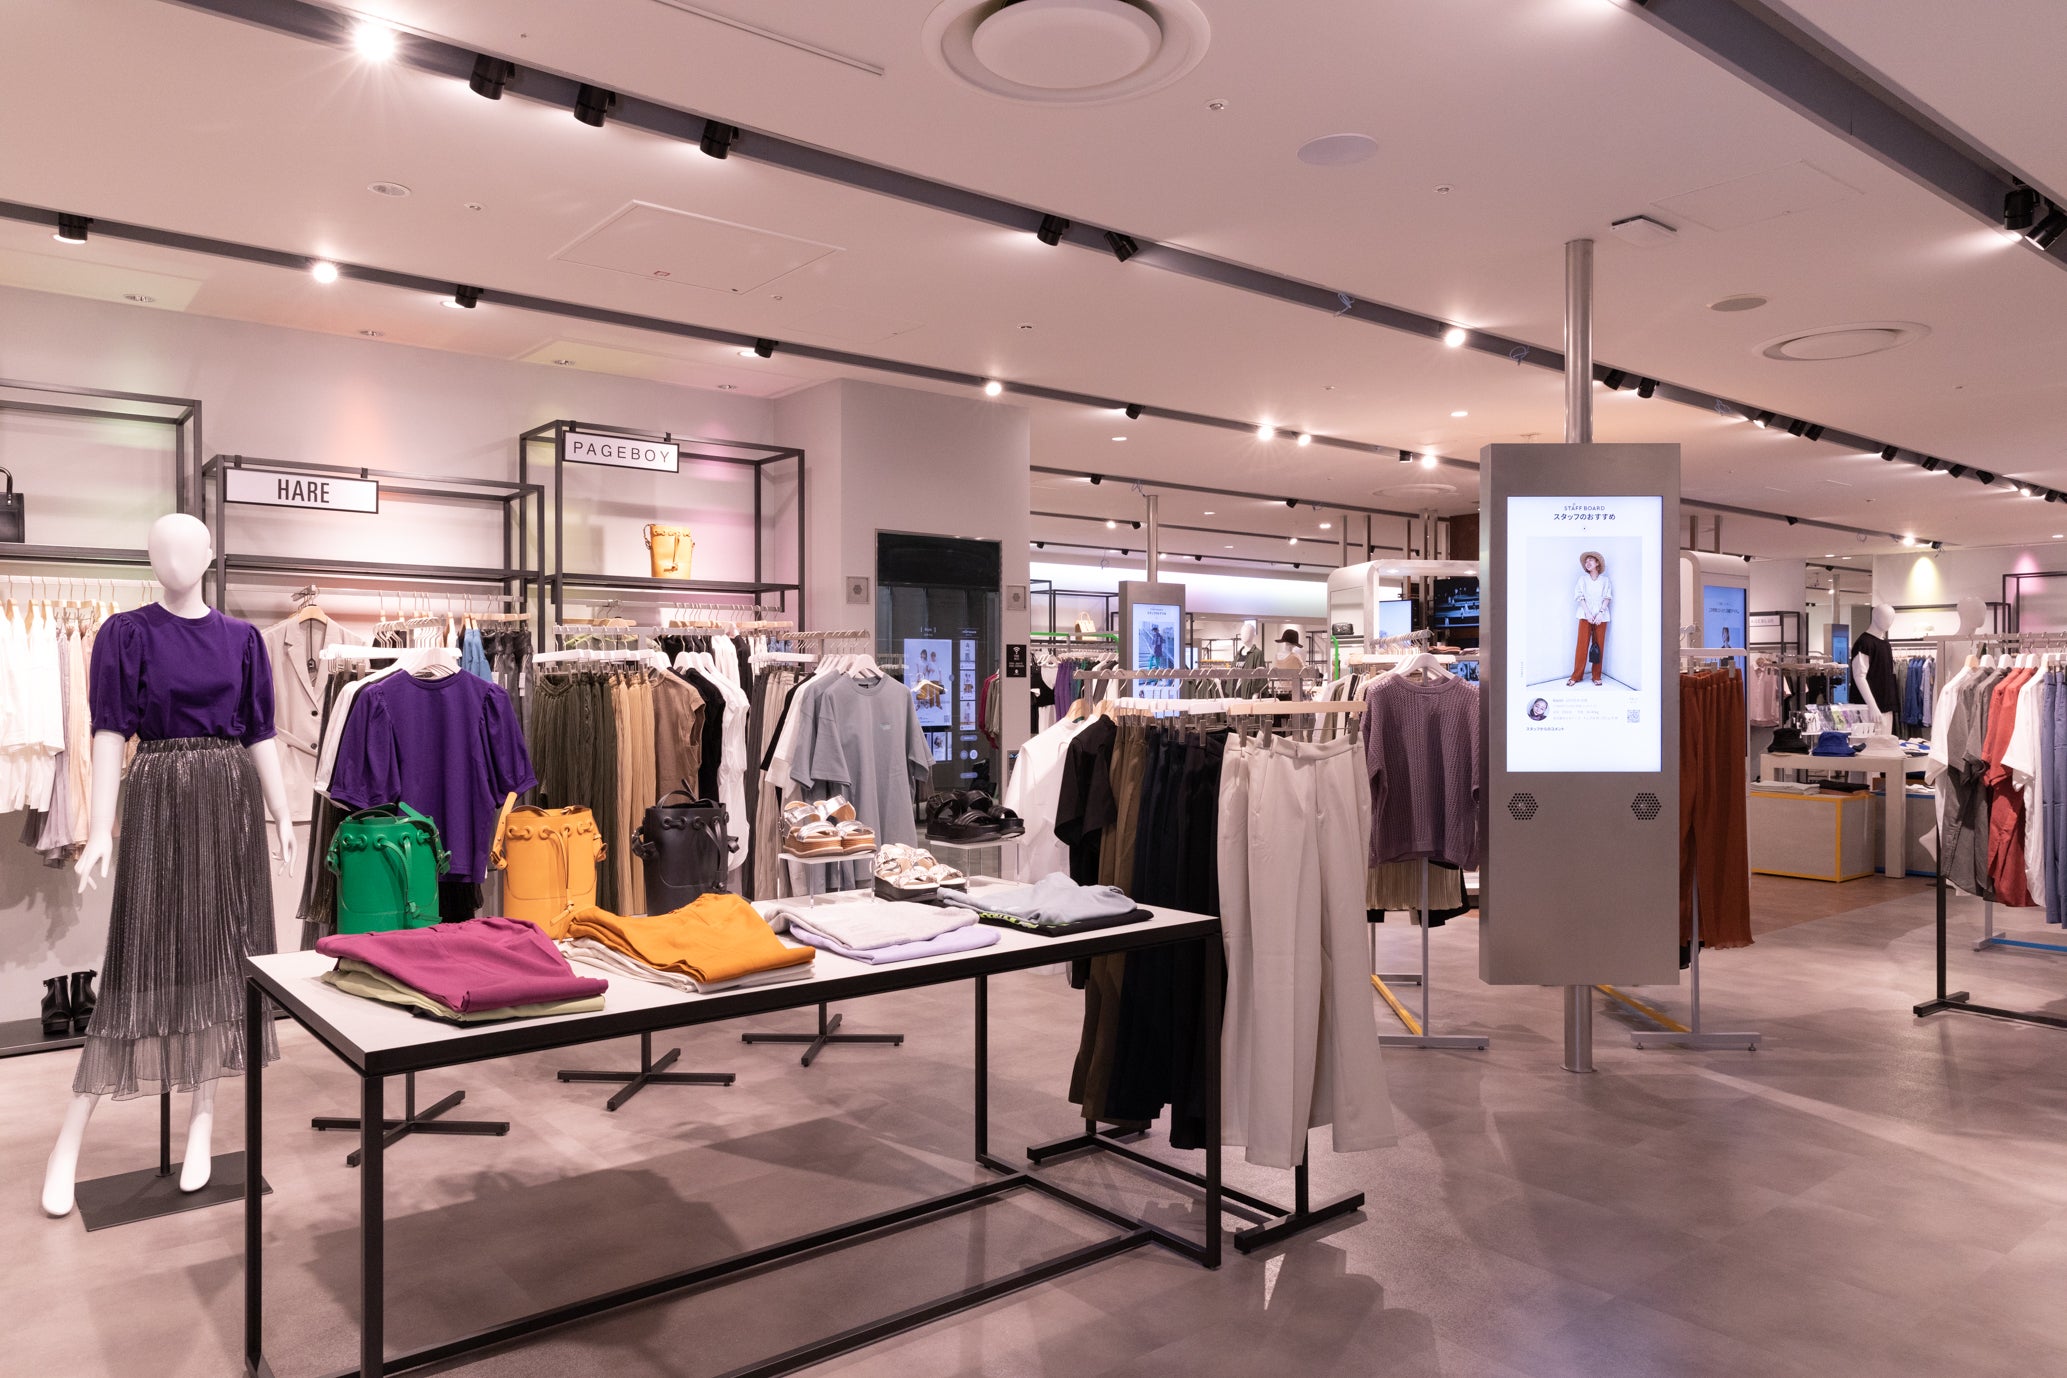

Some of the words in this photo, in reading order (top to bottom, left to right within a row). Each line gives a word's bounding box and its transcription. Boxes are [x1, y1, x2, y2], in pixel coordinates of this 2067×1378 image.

[574, 441, 669, 462] PAGEBOY
[278, 479, 329, 503] HARE
[1553, 513, 1616, 521] スタッフのおすすめ
